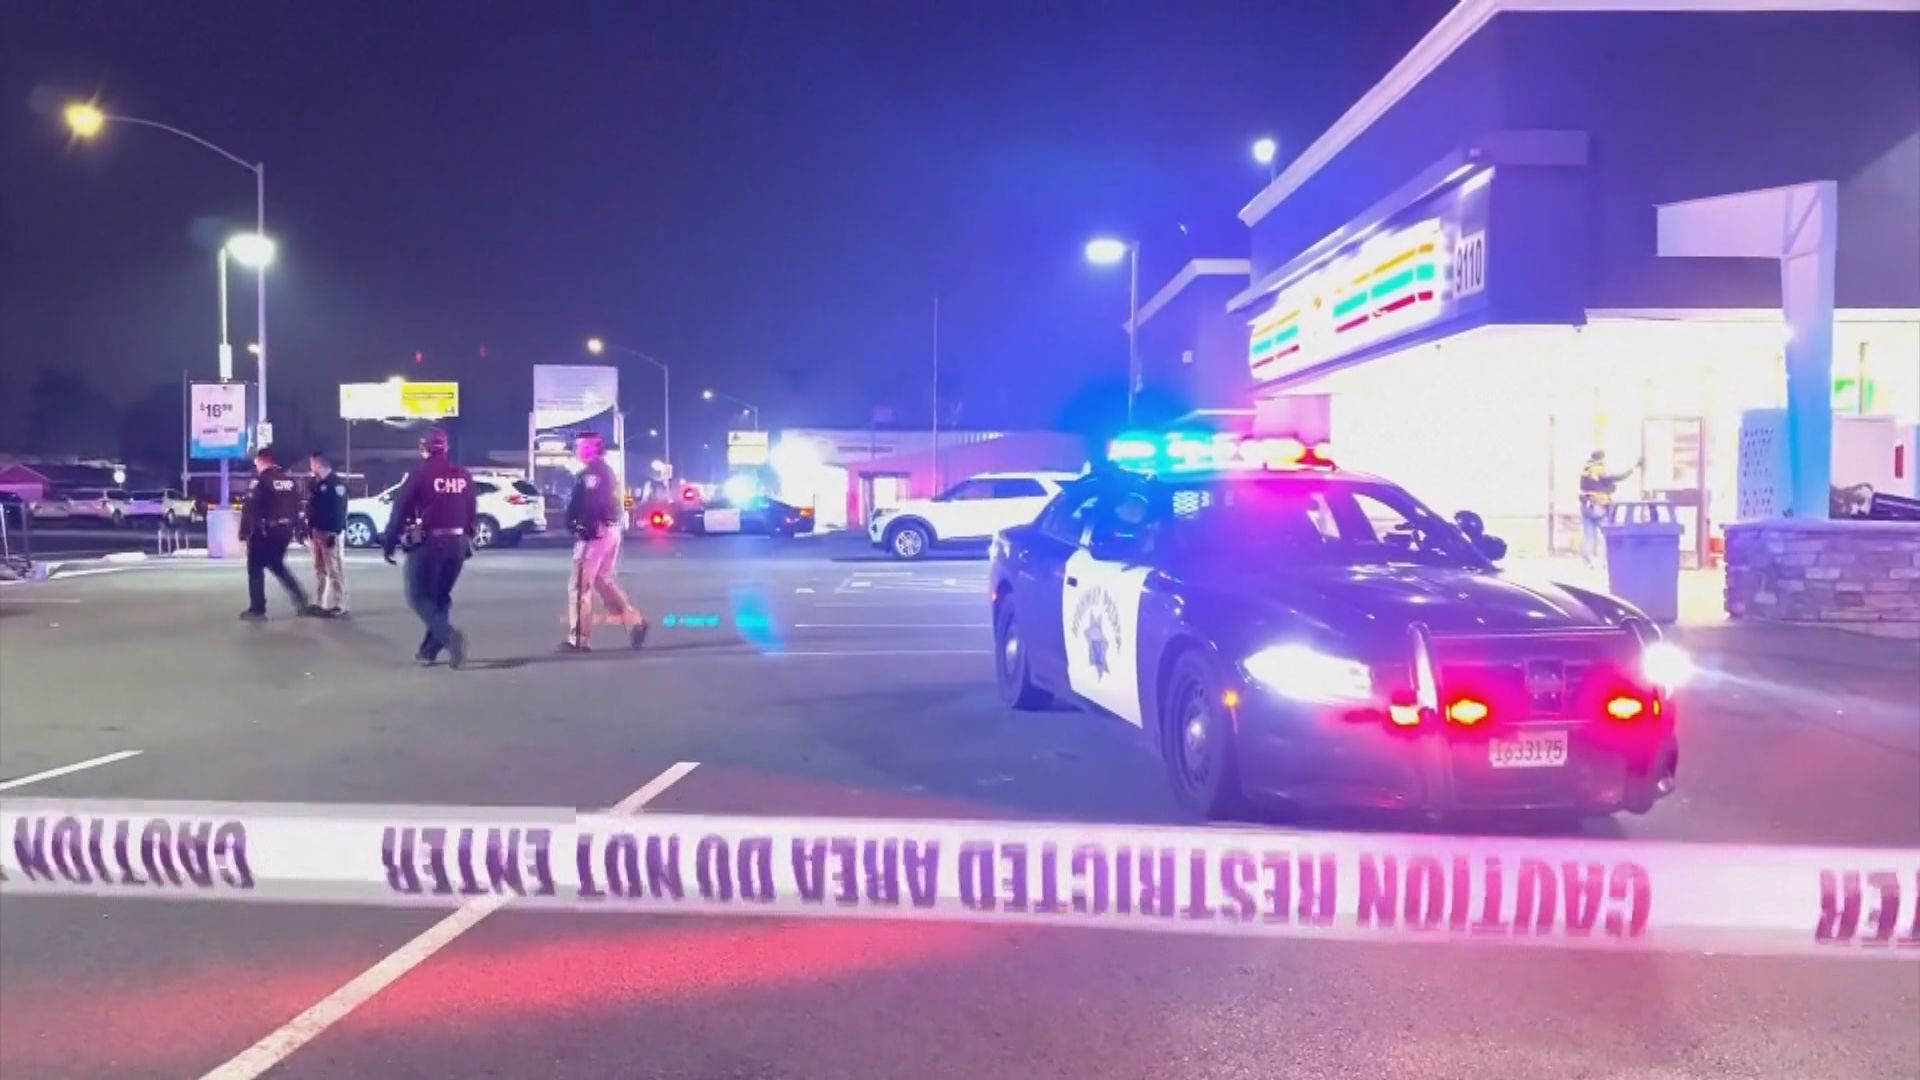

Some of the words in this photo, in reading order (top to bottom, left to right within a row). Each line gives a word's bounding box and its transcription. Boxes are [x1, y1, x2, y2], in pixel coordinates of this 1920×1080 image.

[1456, 238, 1482, 293] 9110
[433, 477, 467, 494] CHP
[12, 815, 254, 889] CAUTION
[381, 826, 558, 897] ENTER
[576, 832, 684, 899] NOT
[696, 835, 774, 904] DO
[790, 838, 942, 910] AREA
[957, 841, 1337, 925] RESTRICTED
[1354, 855, 1653, 938] CAUTION
